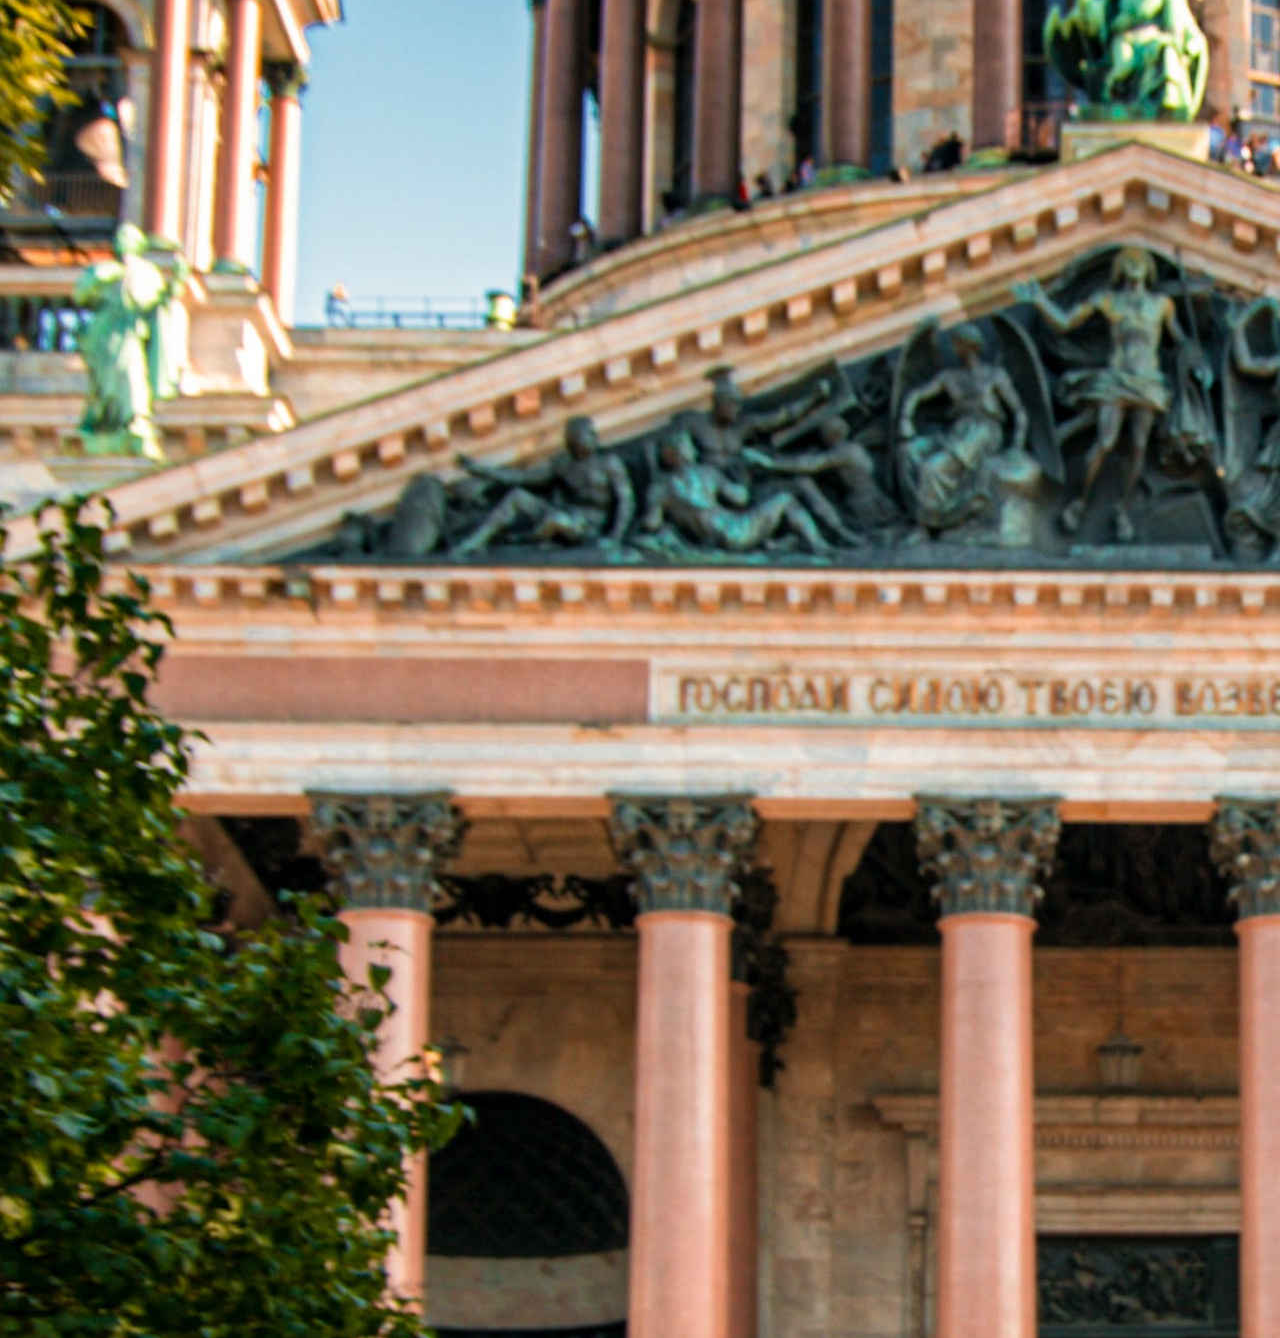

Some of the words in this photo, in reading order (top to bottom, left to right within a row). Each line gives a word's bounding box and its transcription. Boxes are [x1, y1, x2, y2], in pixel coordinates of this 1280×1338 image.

[679, 676, 849, 713] ГОСПОДИ
[868, 677, 1005, 714] СИЛОЮ
[1017, 679, 1157, 716] ТВОЕЮ
